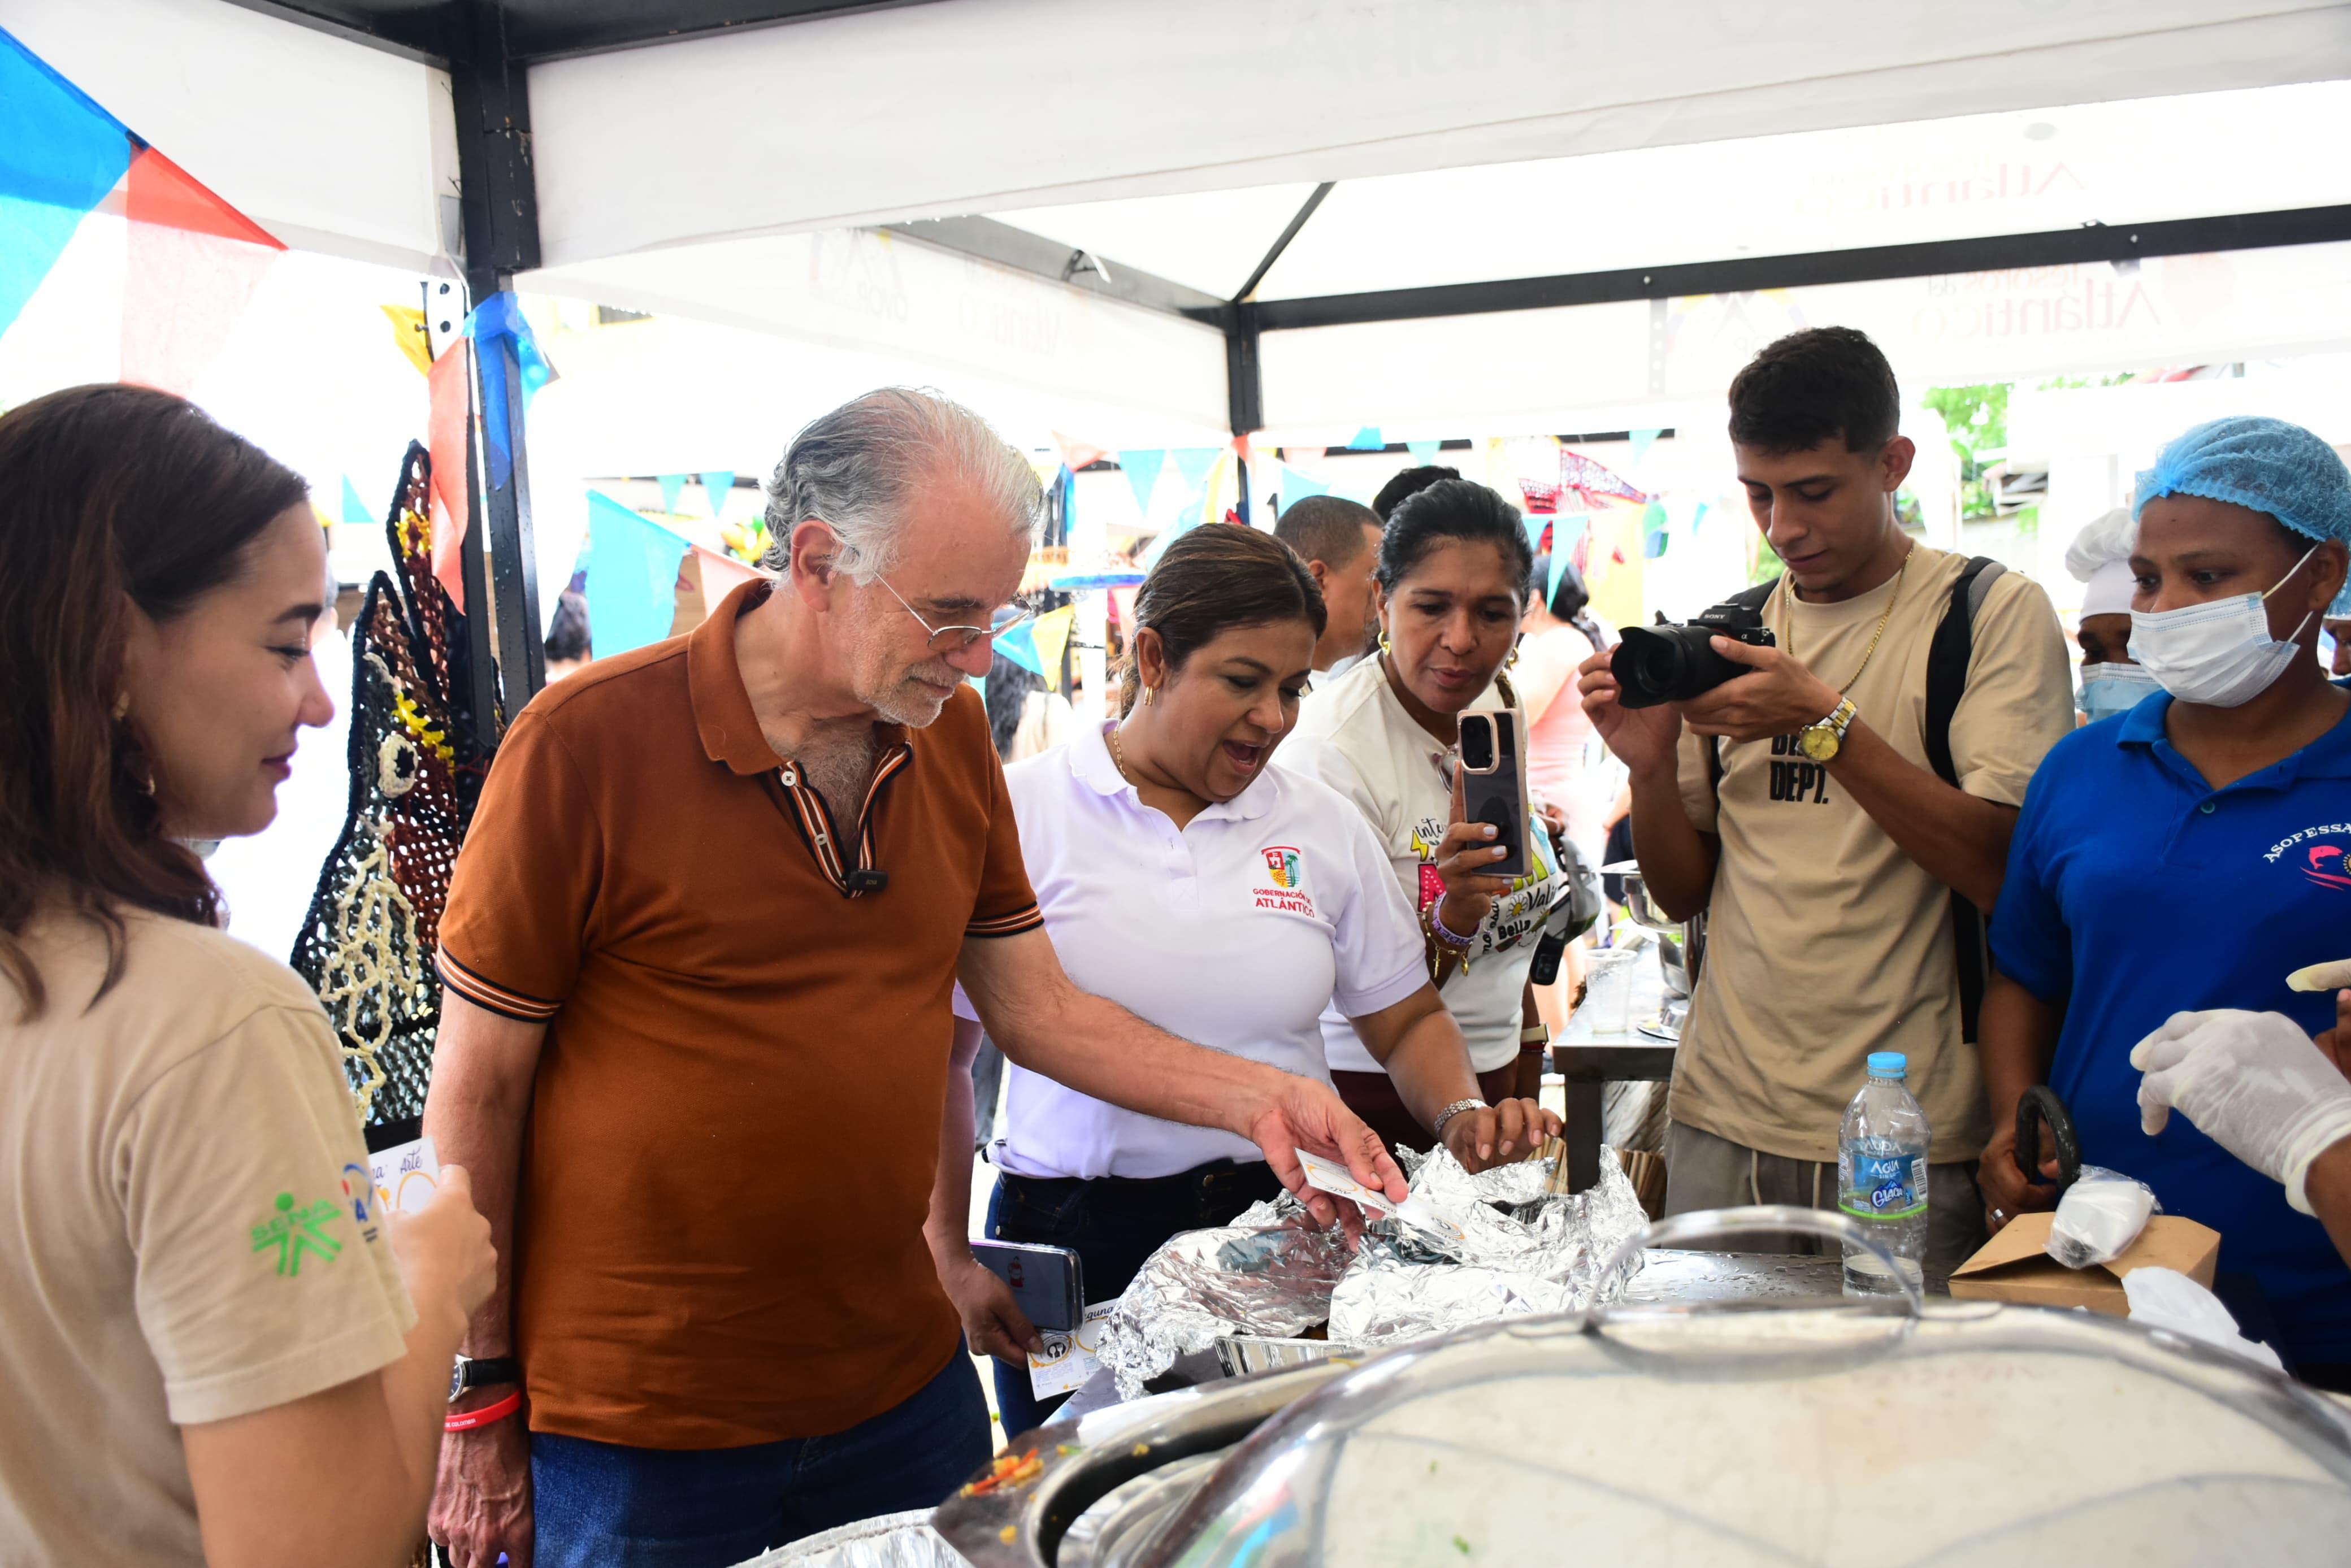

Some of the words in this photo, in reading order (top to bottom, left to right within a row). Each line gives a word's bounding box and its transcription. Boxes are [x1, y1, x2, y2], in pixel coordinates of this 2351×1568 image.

[1255, 897, 1315, 918] ATLÁNTICO
[1498, 919, 1531, 940] Bella
[400, 1145, 423, 1174] Arte
[1871, 1159, 1899, 1174] AGUA
